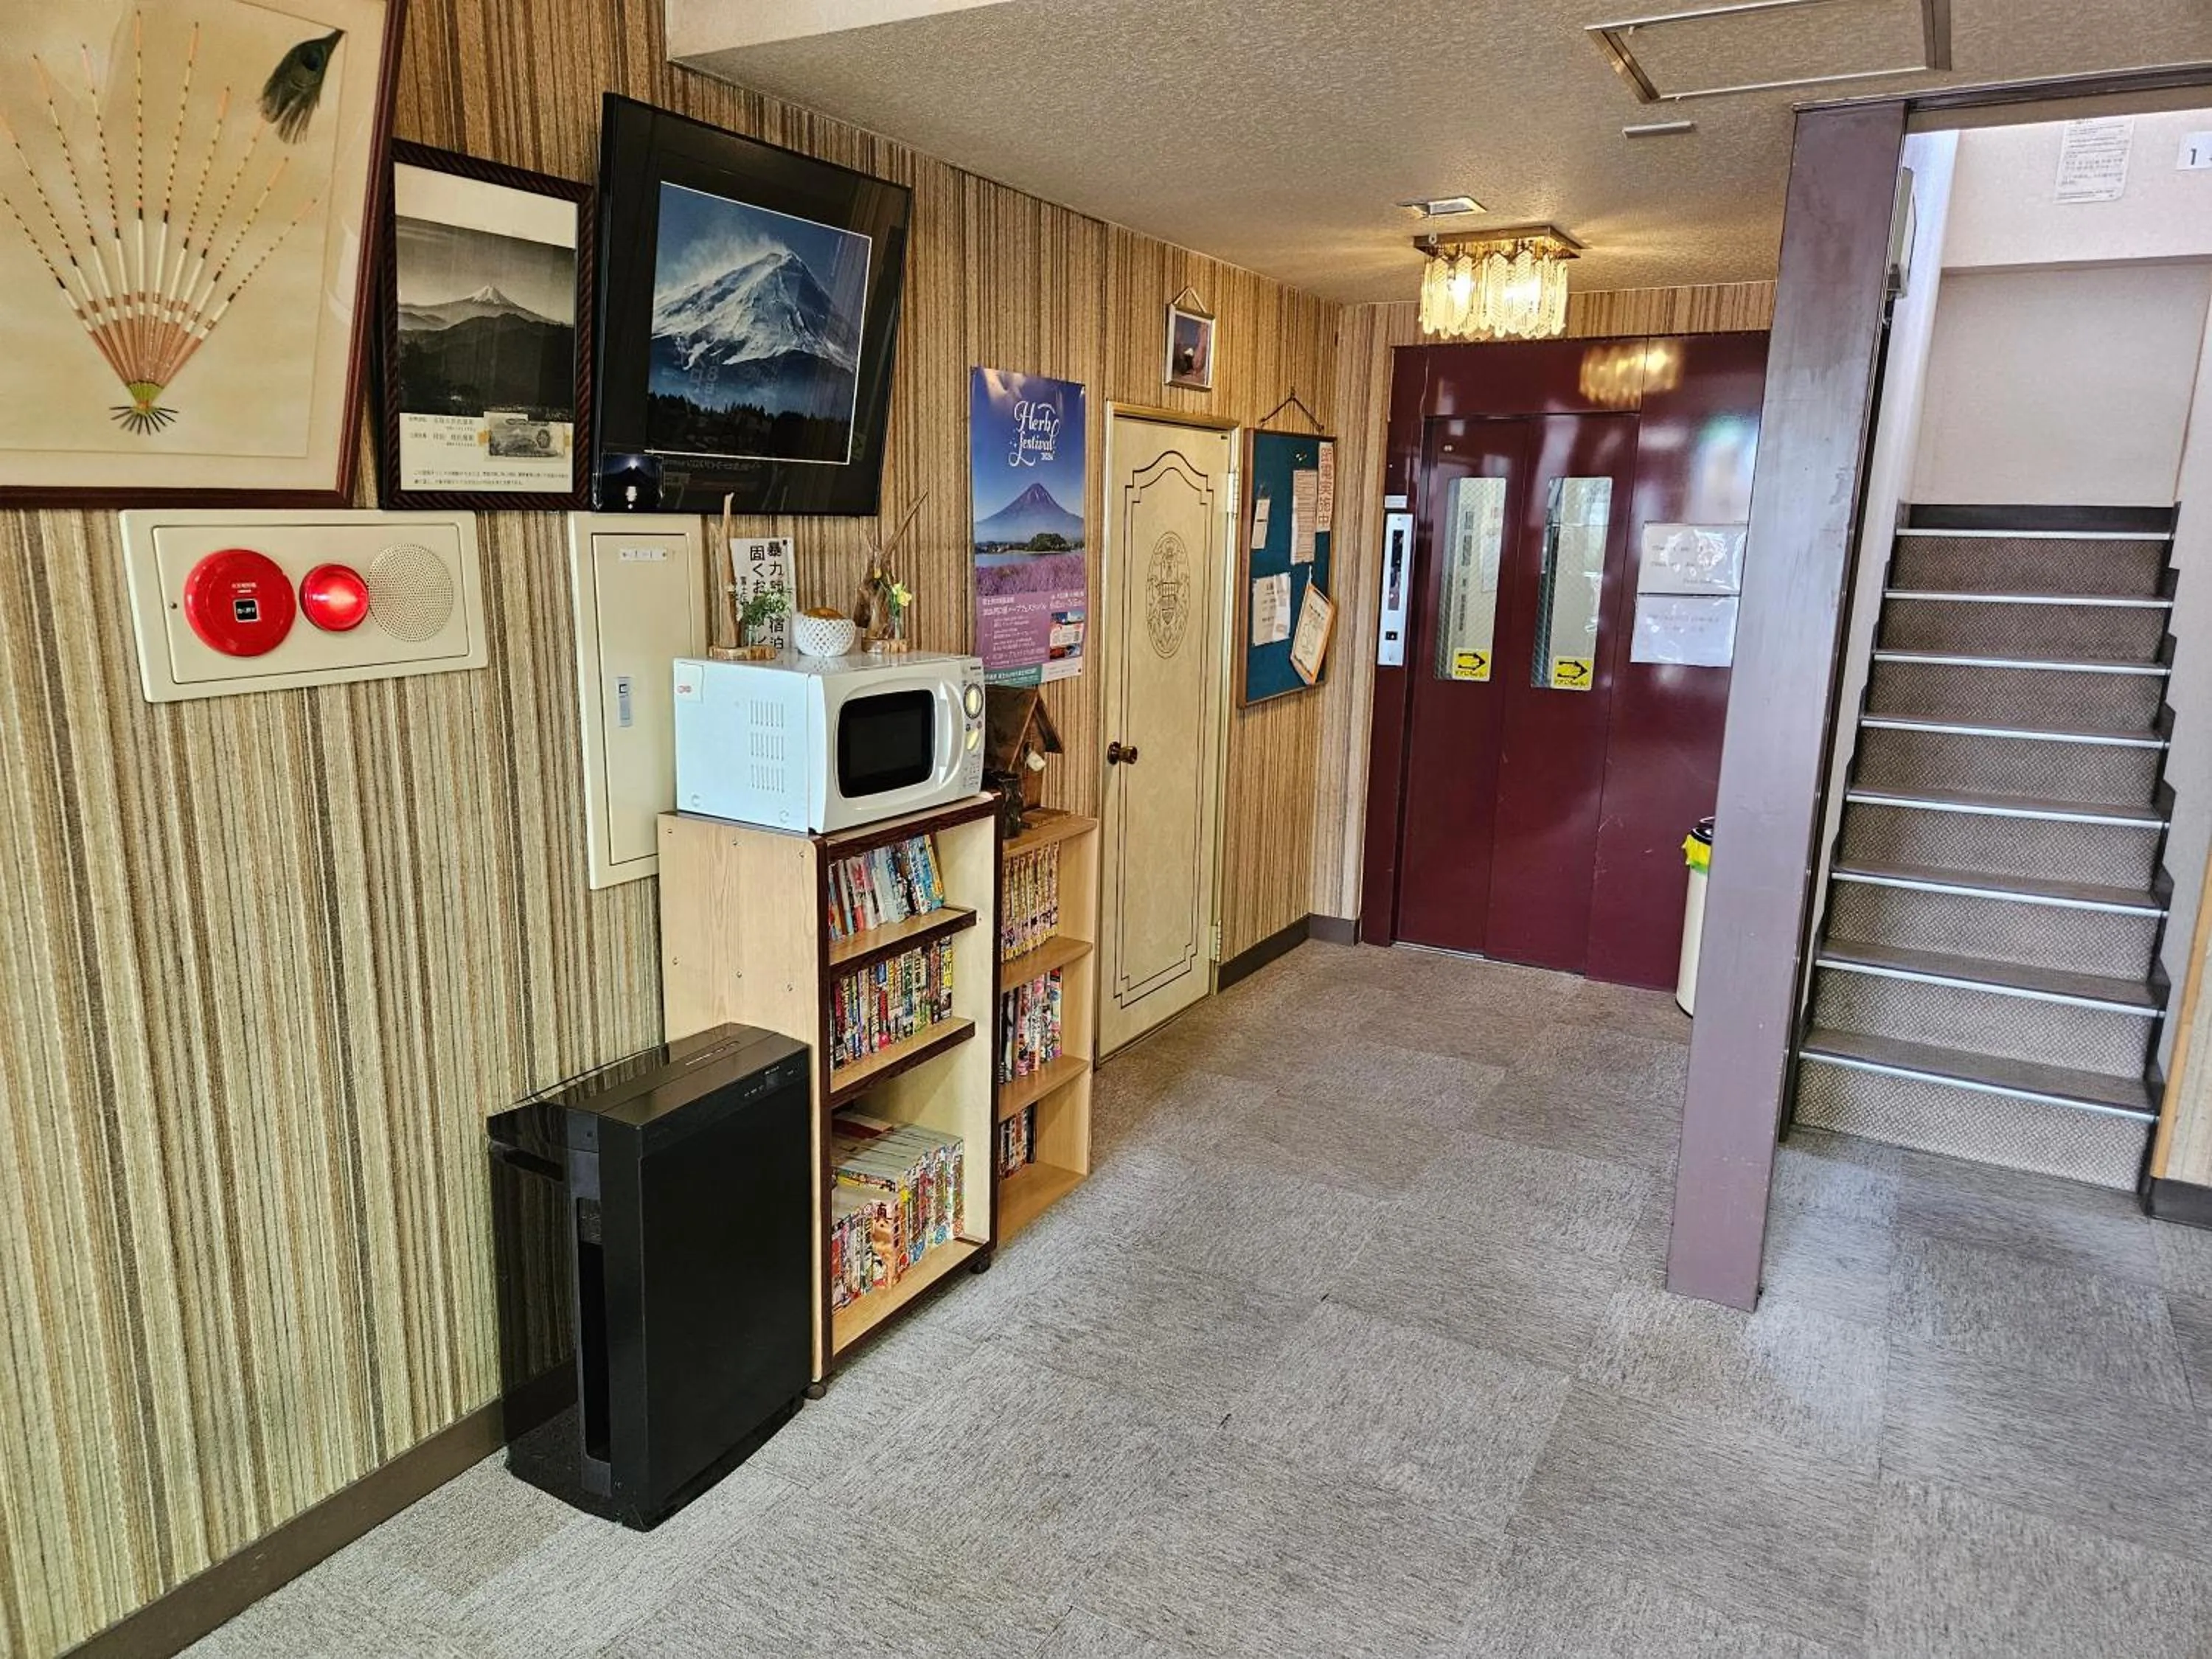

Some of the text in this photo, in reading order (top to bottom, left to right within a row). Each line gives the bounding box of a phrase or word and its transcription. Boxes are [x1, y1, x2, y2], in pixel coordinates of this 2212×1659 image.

[1015, 400, 1056, 432] Herb
[768, 541, 785, 650] 暴力団宿泊
